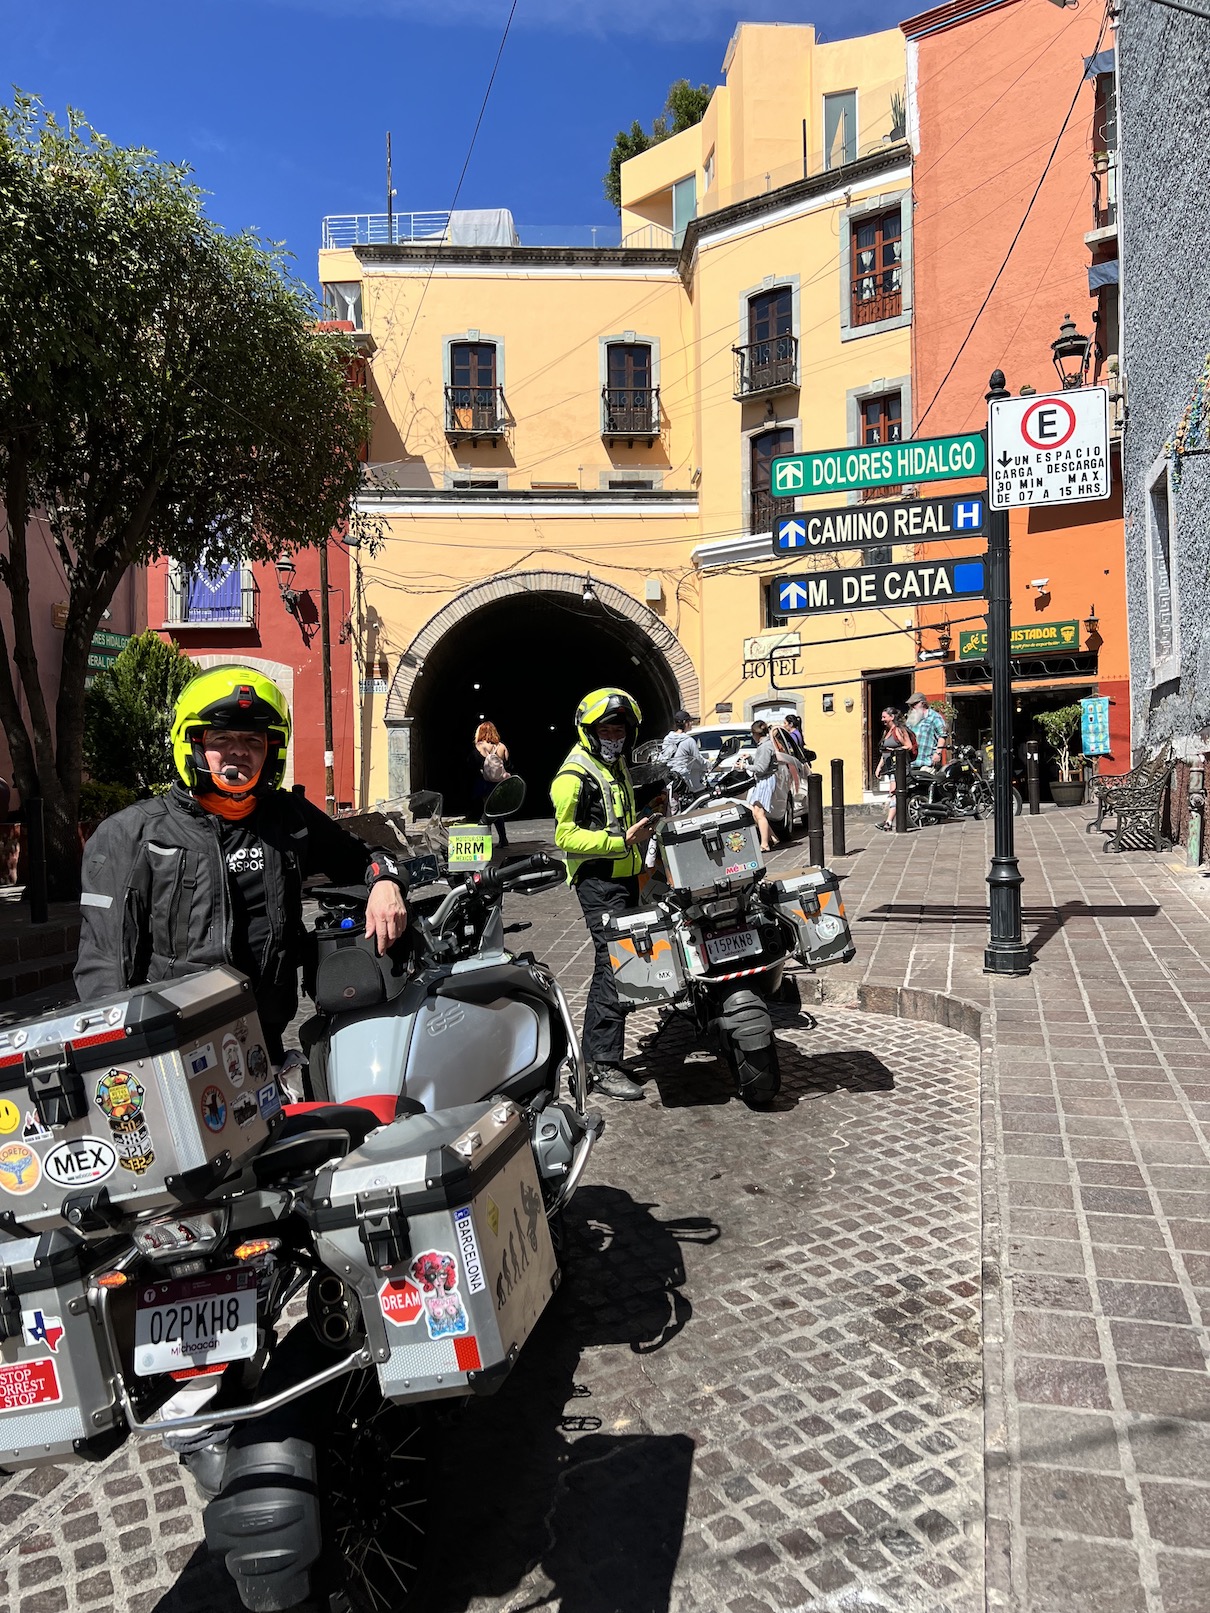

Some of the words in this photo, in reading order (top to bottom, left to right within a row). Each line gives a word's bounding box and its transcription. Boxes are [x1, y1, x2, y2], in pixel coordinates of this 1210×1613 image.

[1038, 409, 1058, 439] E
[812, 450, 893, 486] DOLORES
[897, 441, 975, 477] HIDALGO
[1014, 455, 1029, 466] UN
[1036, 446, 1101, 463] ESPACIO
[995, 467, 1033, 480] CARGA
[1047, 458, 1105, 474] DESCARGA
[997, 481, 1012, 492] 30
[1019, 477, 1043, 490] MIN
[997, 493, 1010, 504] DE
[1019, 490, 1034, 501] 07
[1043, 489, 1050, 499] A
[1059, 486, 1072, 497] 15
[808, 511, 888, 545] CAMINO
[894, 504, 951, 537] REAL
[957, 503, 980, 528] H
[808, 579, 835, 608] M.
[842, 574, 877, 604] DE
[884, 566, 953, 600] CATA
[962, 633, 980, 653] café
[742, 658, 804, 680] HOTEL
[456, 842, 484, 855] RRM
[659, 970, 671, 979] MX
[120, 1120, 136, 1132] 50
[121, 1132, 140, 1145] 88
[53, 1146, 107, 1176] MEX
[125, 1145, 143, 1158] 121
[128, 1157, 147, 1170] 132
[457, 1218, 484, 1293] BARCELONA
[381, 1293, 421, 1312] DREAM
[150, 1297, 240, 1346] 02PKH8
[170, 1337, 220, 1357] Michoacán
[0, 1369, 31, 1385] STOP
[4, 1391, 37, 1408] STOP
